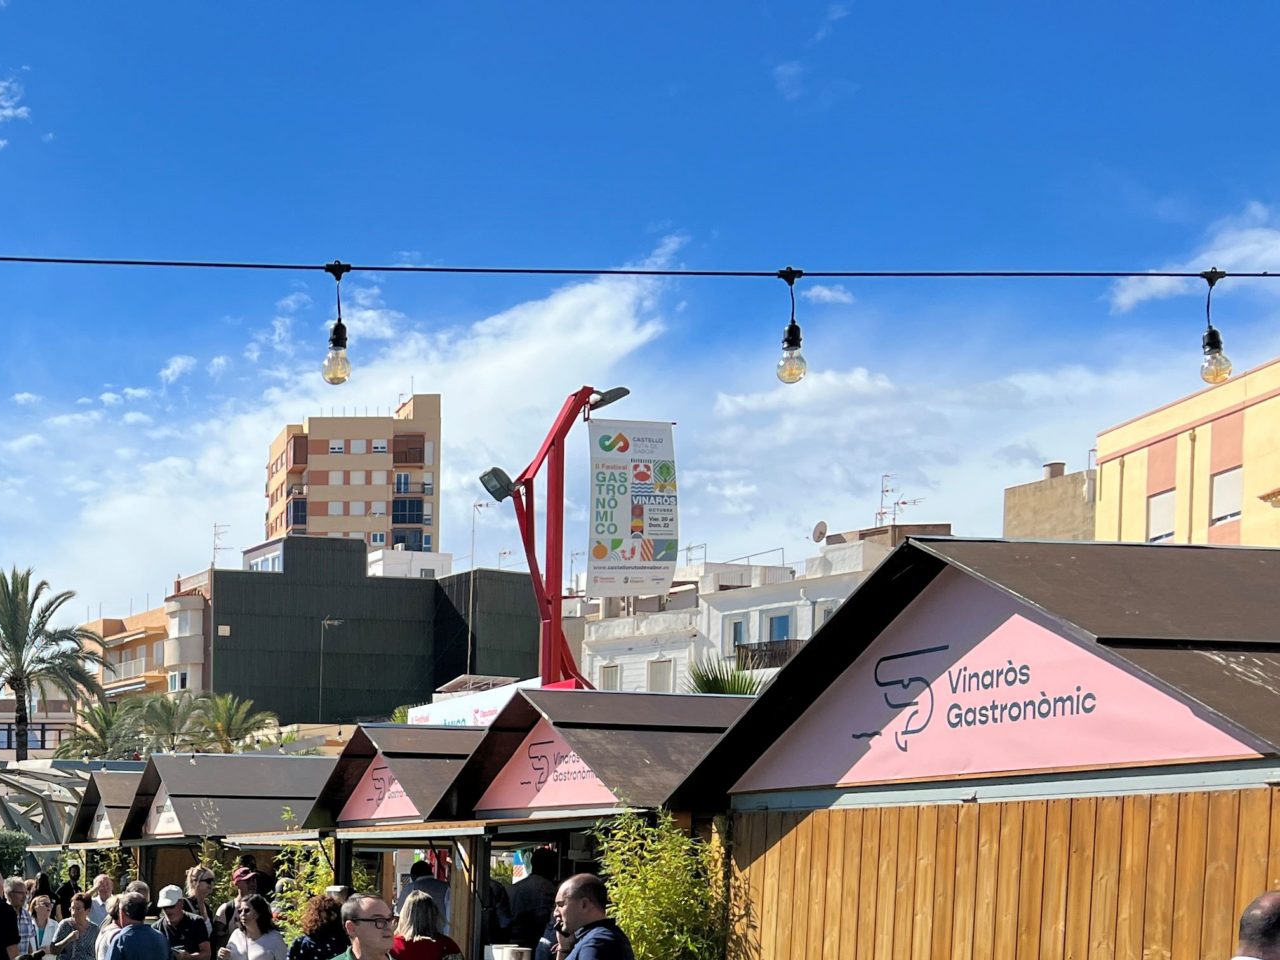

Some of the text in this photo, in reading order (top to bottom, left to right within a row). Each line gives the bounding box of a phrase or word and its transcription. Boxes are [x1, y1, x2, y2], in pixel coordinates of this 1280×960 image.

[601, 463, 628, 471] Festival
[595, 471, 628, 484] GAS
[595, 484, 628, 496] TRO
[595, 510, 614, 522] MI
[595, 523, 618, 535] CO
[947, 659, 1031, 694] Vinaròs
[946, 685, 1097, 729] Gastronòmic
